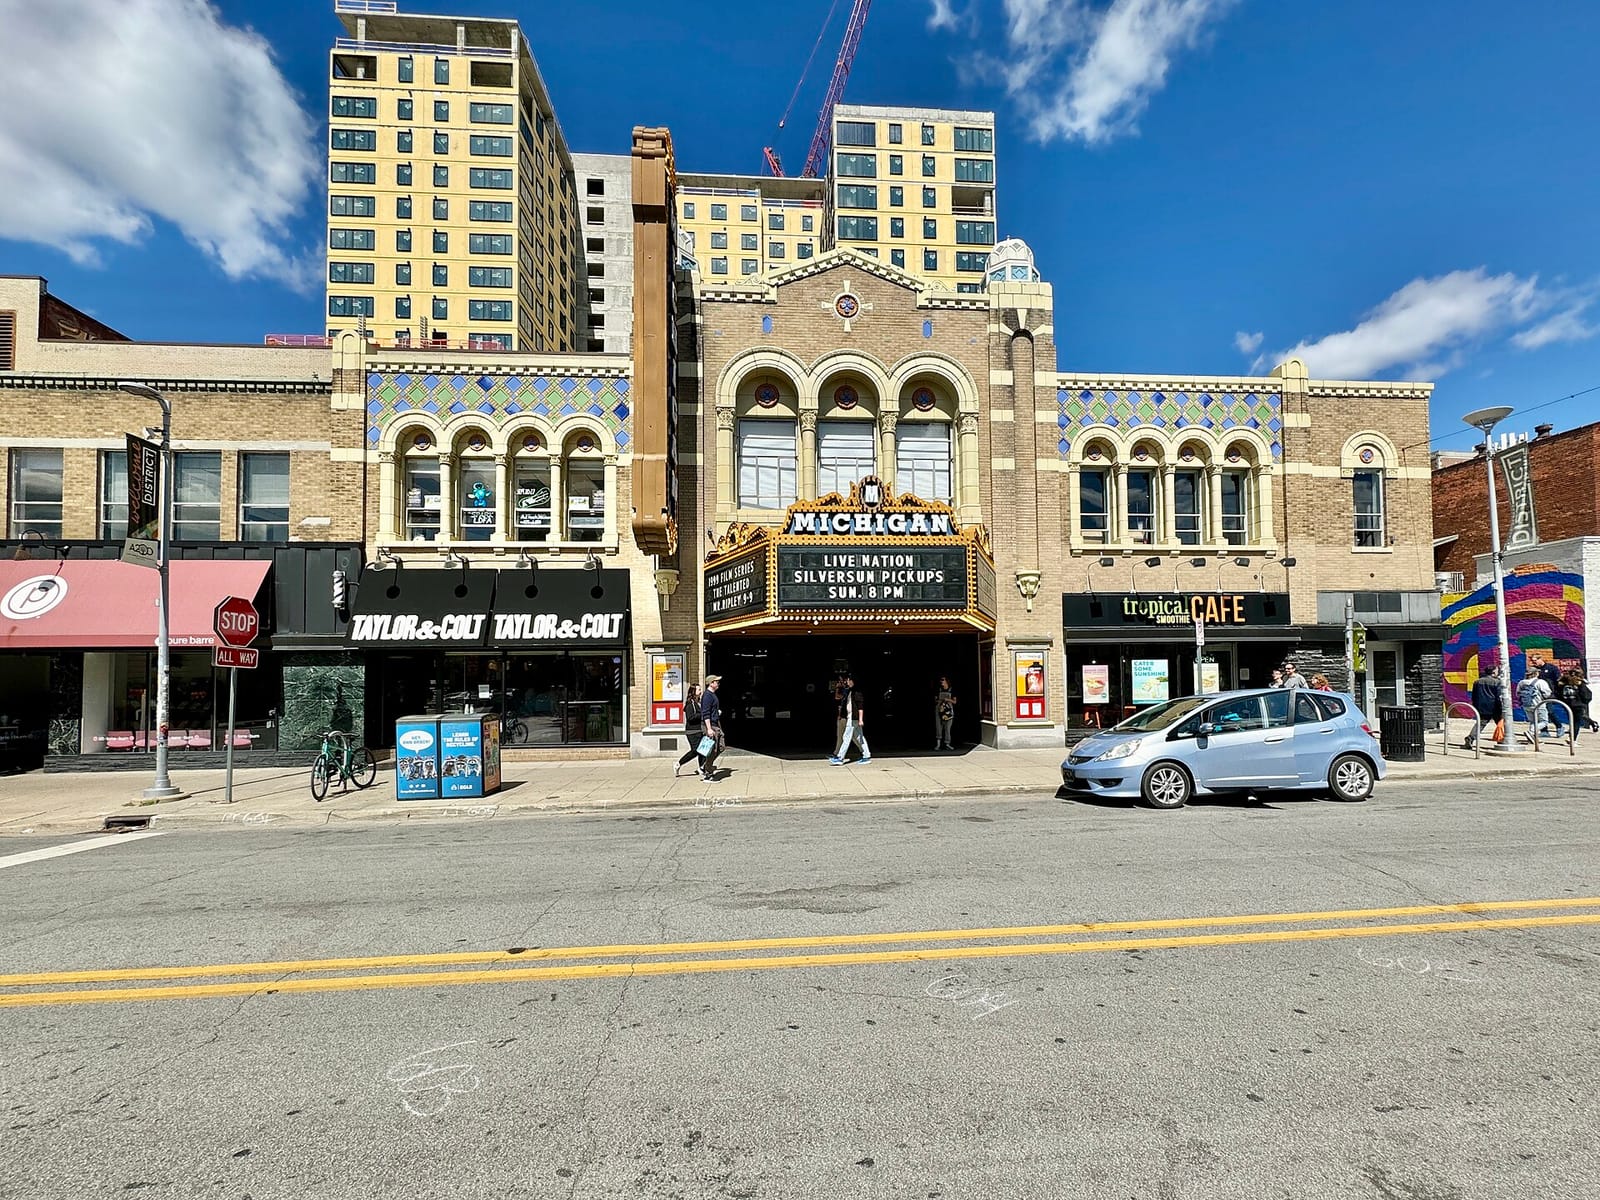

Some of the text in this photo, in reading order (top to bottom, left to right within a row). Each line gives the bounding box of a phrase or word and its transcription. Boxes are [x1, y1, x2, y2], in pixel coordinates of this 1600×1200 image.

[144, 450, 155, 502] DISTRICT
[865, 485, 878, 503] M
[1507, 458, 1530, 544] DISTRICT
[793, 512, 949, 533] MICHIGAN
[824, 554, 913, 567] LIVE NATION
[708, 560, 754, 587] 1999 FILM SERIES
[794, 570, 944, 583] SILVERSUN PICKUPS
[713, 577, 750, 599] THE TALENTED
[829, 586, 904, 599] SUN. 8 PM
[1123, 595, 1246, 622] tropical CAFE
[221, 611, 256, 632] STOP
[1156, 615, 1191, 624] SMOOTHIE
[189, 635, 215, 645] barre
[218, 650, 256, 664] ALL WAY
